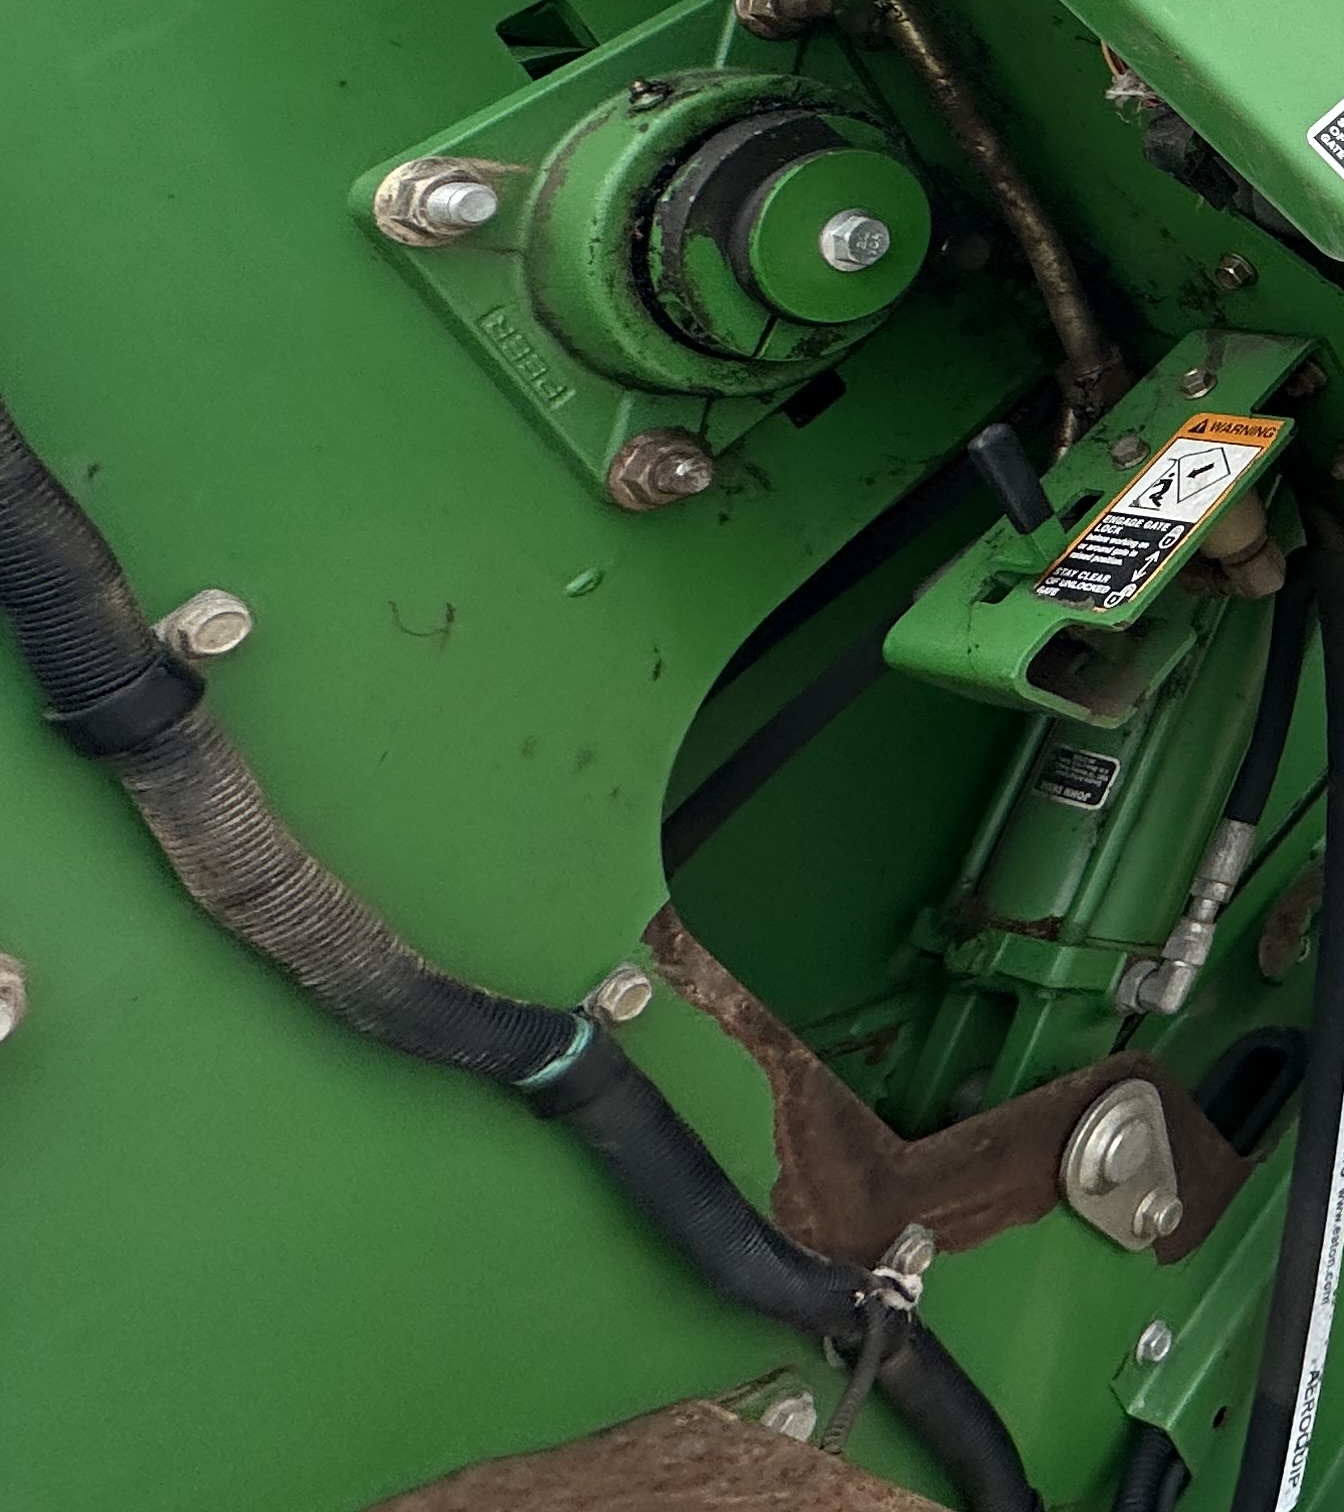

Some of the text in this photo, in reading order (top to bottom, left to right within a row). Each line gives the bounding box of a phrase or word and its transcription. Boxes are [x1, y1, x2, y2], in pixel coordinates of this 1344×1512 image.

[1209, 420, 1277, 439] WARNING
[1094, 523, 1124, 535] LOCK
[1102, 514, 1171, 532] ENGAGE GATE
[1052, 567, 1112, 584] STAY CLEAR
[1045, 576, 1111, 594] OF UNLOCKED
[1321, 1188, 1344, 1306] www.eaton.com
[1288, 1368, 1321, 1488] AEROQUIP
